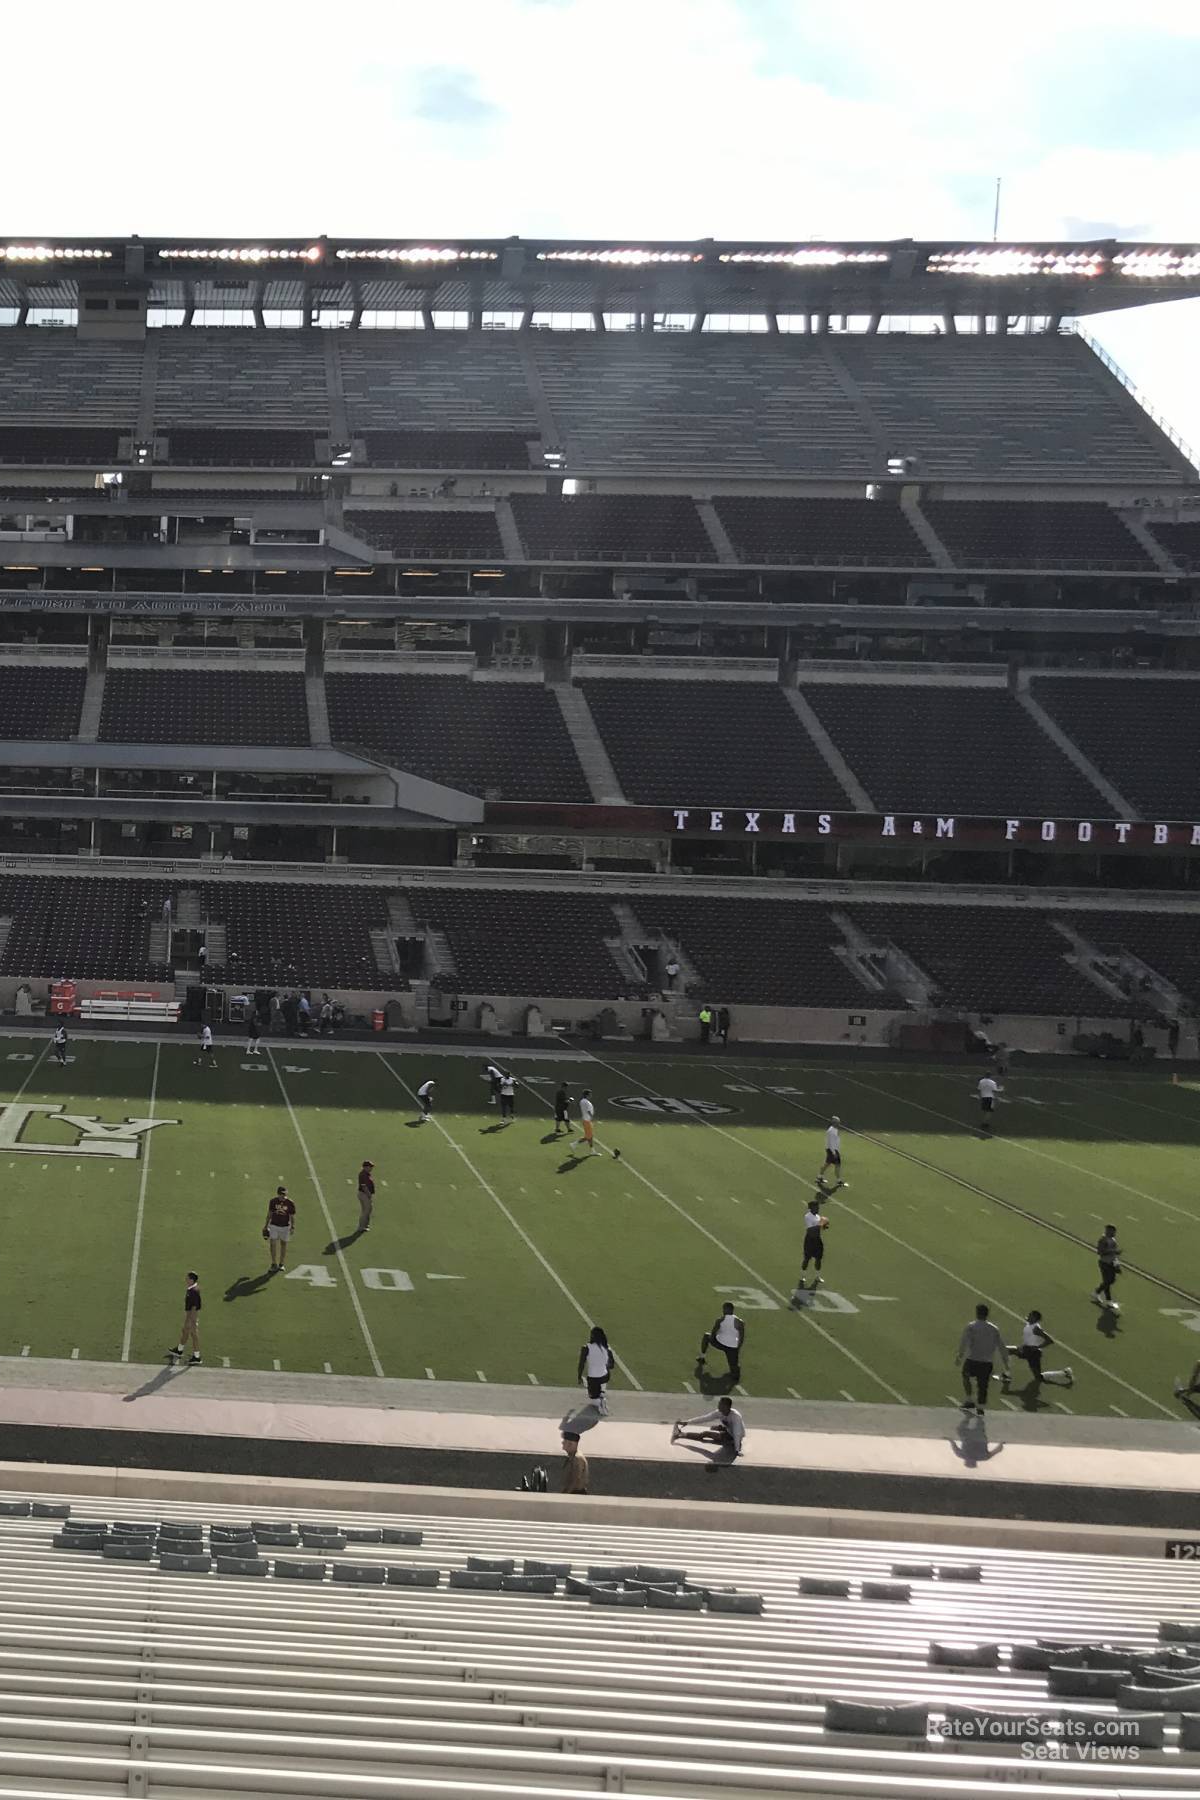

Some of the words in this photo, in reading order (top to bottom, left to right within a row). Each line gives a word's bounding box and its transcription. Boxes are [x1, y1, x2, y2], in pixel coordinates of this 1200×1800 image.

[673, 810, 831, 834] TEXAS
[881, 815, 955, 838] A&M
[284, 1264, 415, 1291] 40
[712, 1286, 861, 1314] 30
